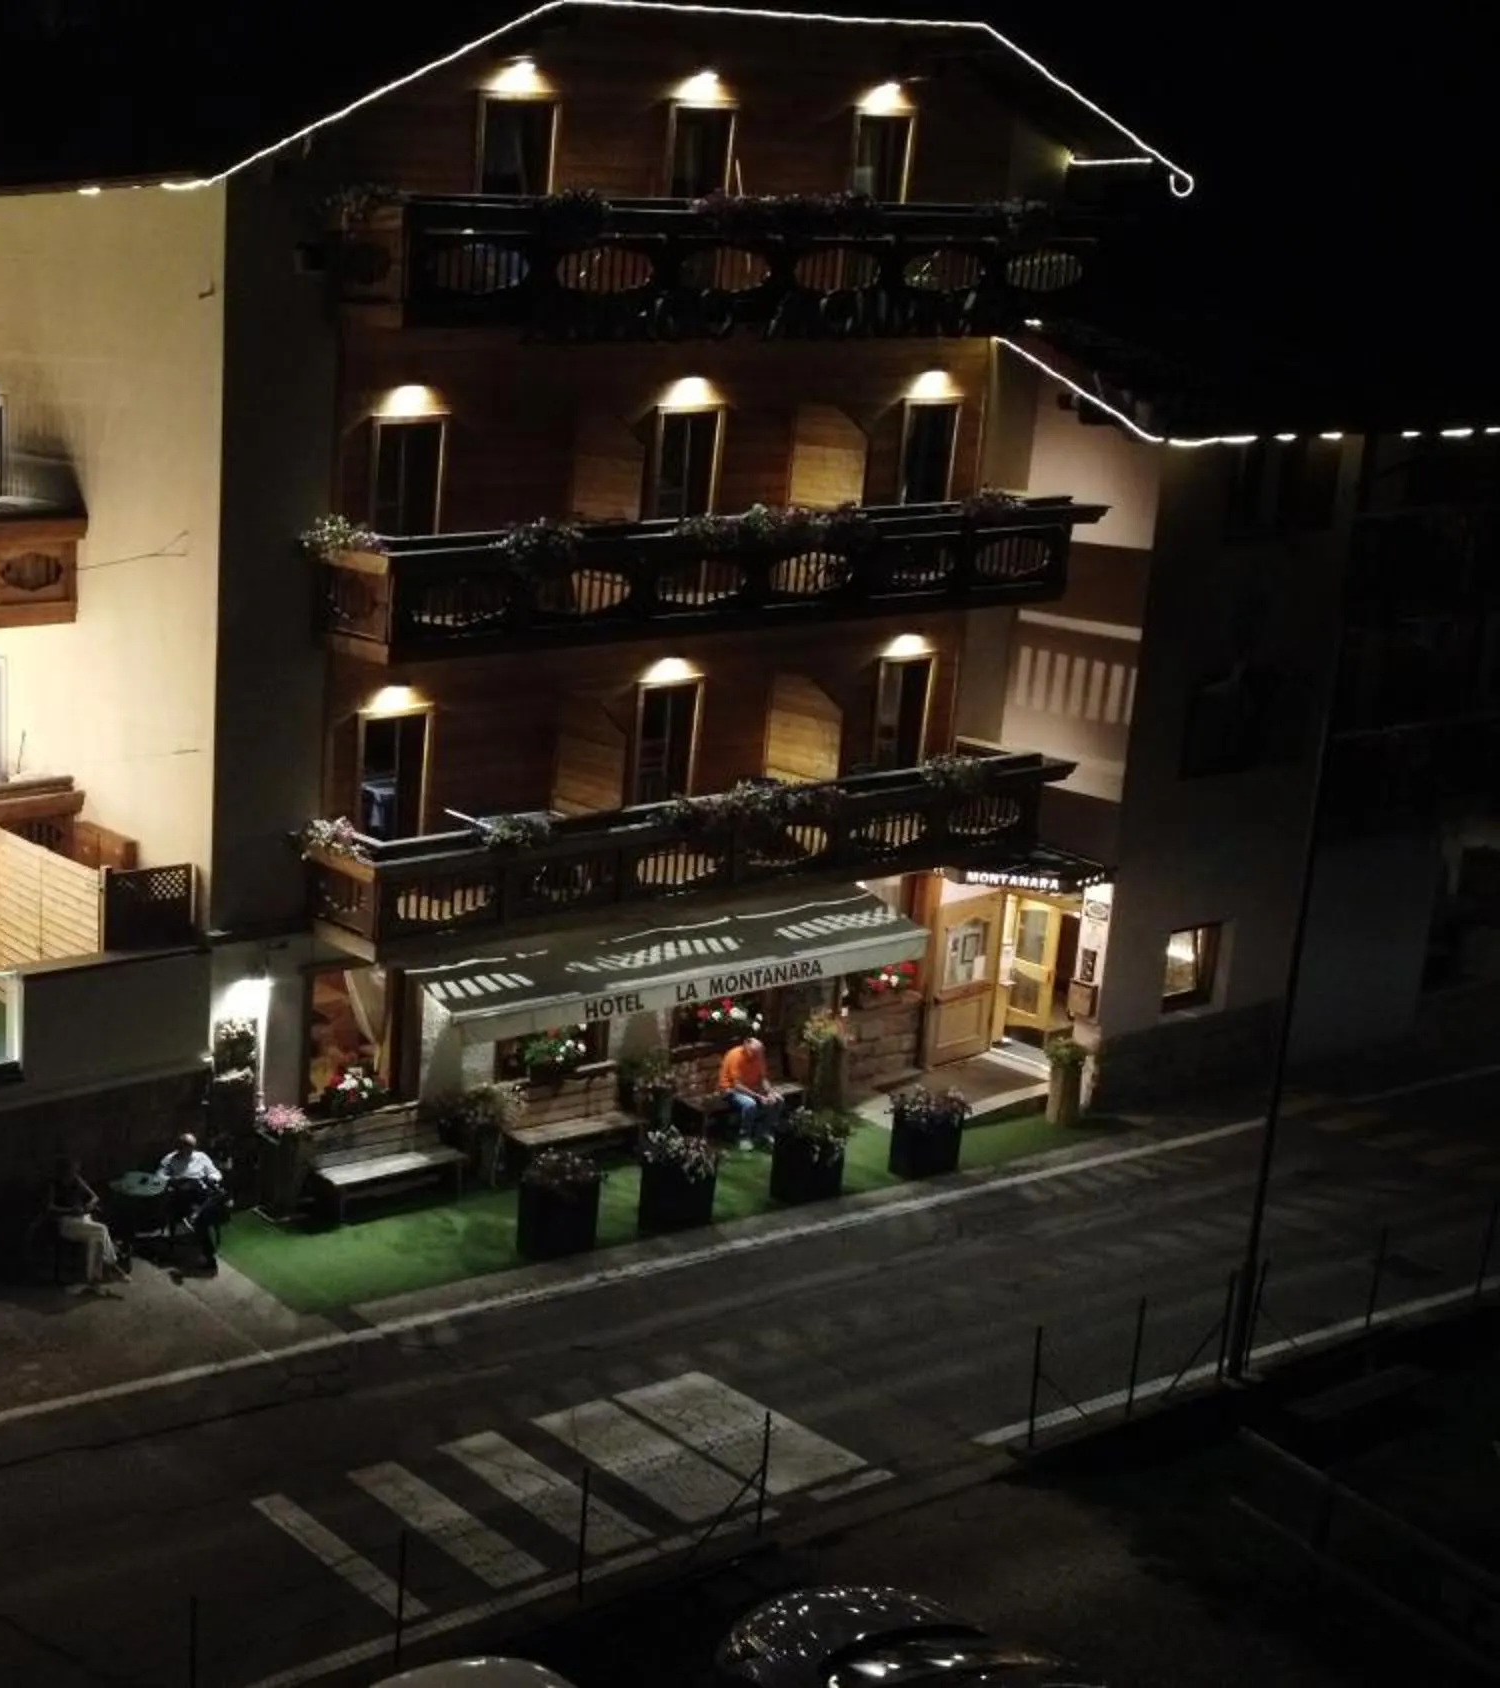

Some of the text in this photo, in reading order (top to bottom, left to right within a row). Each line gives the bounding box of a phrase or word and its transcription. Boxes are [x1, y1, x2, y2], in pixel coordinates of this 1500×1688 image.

[966, 871, 1060, 891] MONTANARA
[584, 960, 823, 1020] HOTEL LA MONTANARA
